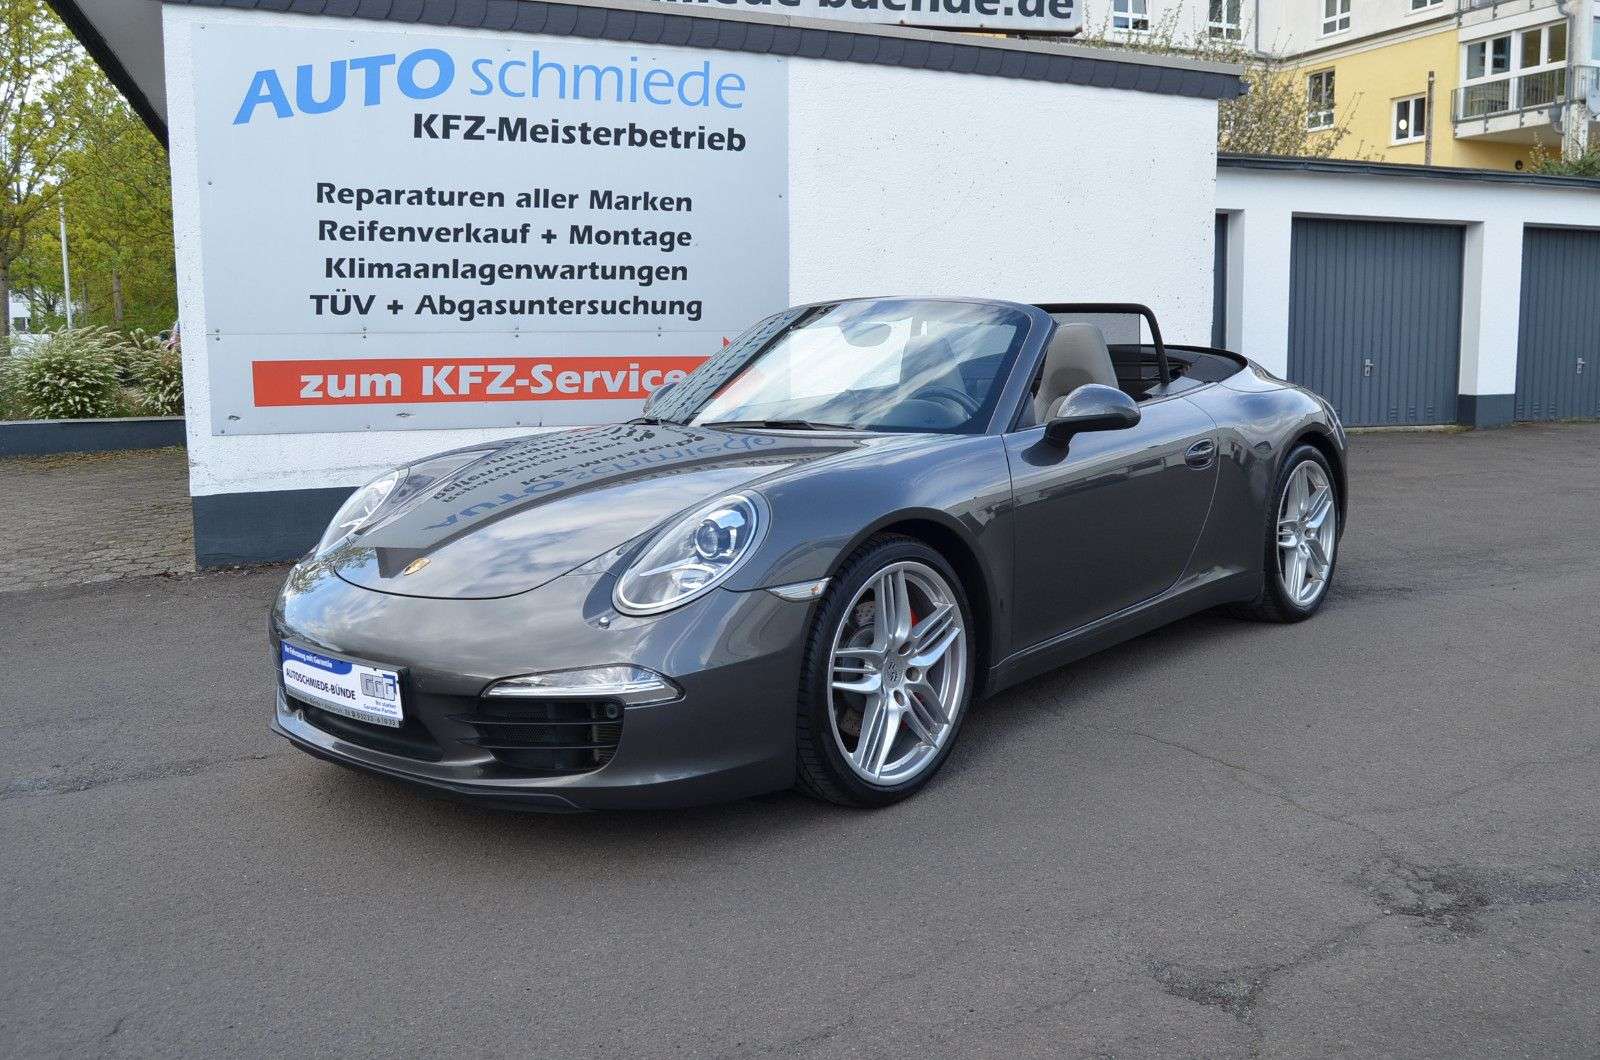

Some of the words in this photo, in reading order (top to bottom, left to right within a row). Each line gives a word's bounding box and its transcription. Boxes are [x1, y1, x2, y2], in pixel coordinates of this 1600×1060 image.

[232, 48, 455, 126] AUTO
[470, 49, 746, 110] schmiede
[414, 113, 746, 152] KFZ-Meisterbetrieb
[317, 183, 504, 210] Reparaturen
[516, 188, 578, 209] aller
[590, 190, 692, 212] Marken
[319, 220, 530, 244] Reifenverkauf
[541, 229, 557, 244] +
[570, 225, 692, 252] Montage
[325, 258, 687, 286] Klimaanlagenwartungen
[310, 289, 376, 316] TÜV
[387, 299, 403, 315] +
[415, 295, 702, 321] Abgasuntersuchung
[300, 372, 401, 399] zum
[421, 363, 686, 396] KFZ-Service
